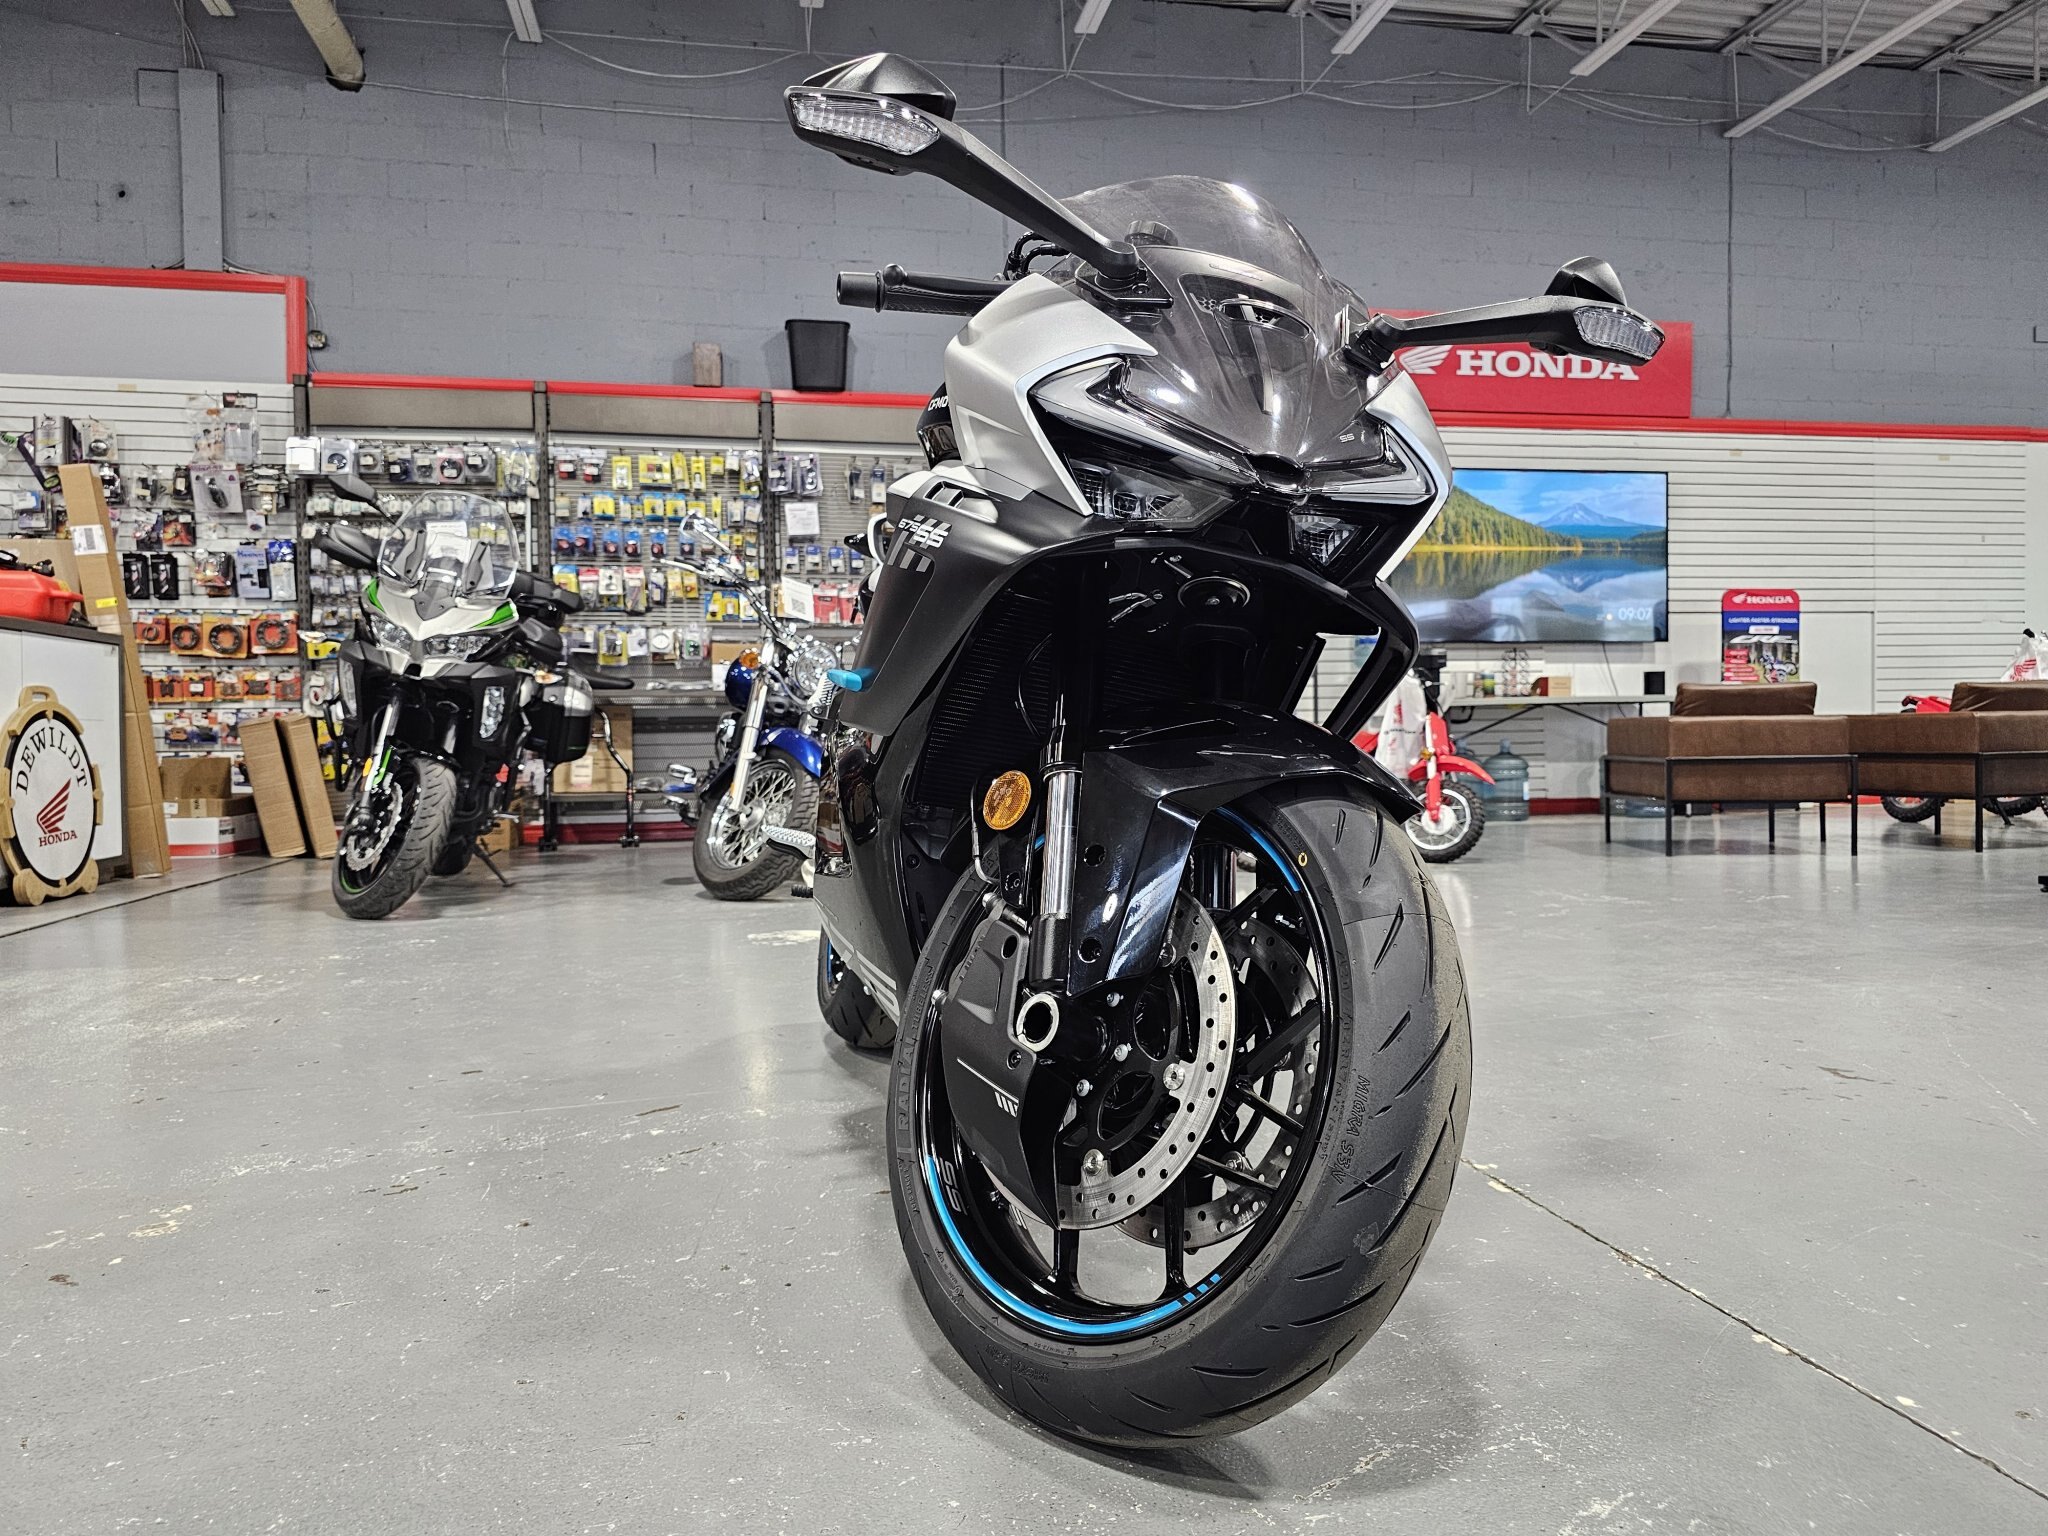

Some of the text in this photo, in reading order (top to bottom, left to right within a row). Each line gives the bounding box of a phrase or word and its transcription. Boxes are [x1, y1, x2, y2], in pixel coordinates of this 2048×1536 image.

[1456, 350, 1639, 381] HONDA
[928, 396, 949, 411] CFMO
[1339, 433, 1355, 443] SS
[1618, 607, 1652, 621] 09:07
[1746, 595, 1794, 604] HONDA
[15, 726, 89, 795] DEWILDT
[38, 829, 78, 847] HONDA
[911, 968, 935, 1031] TUBELESS
[896, 1033, 919, 1132] RADIAL
[1346, 1075, 1371, 1136] MIGRA
[939, 1157, 968, 1216] SS
